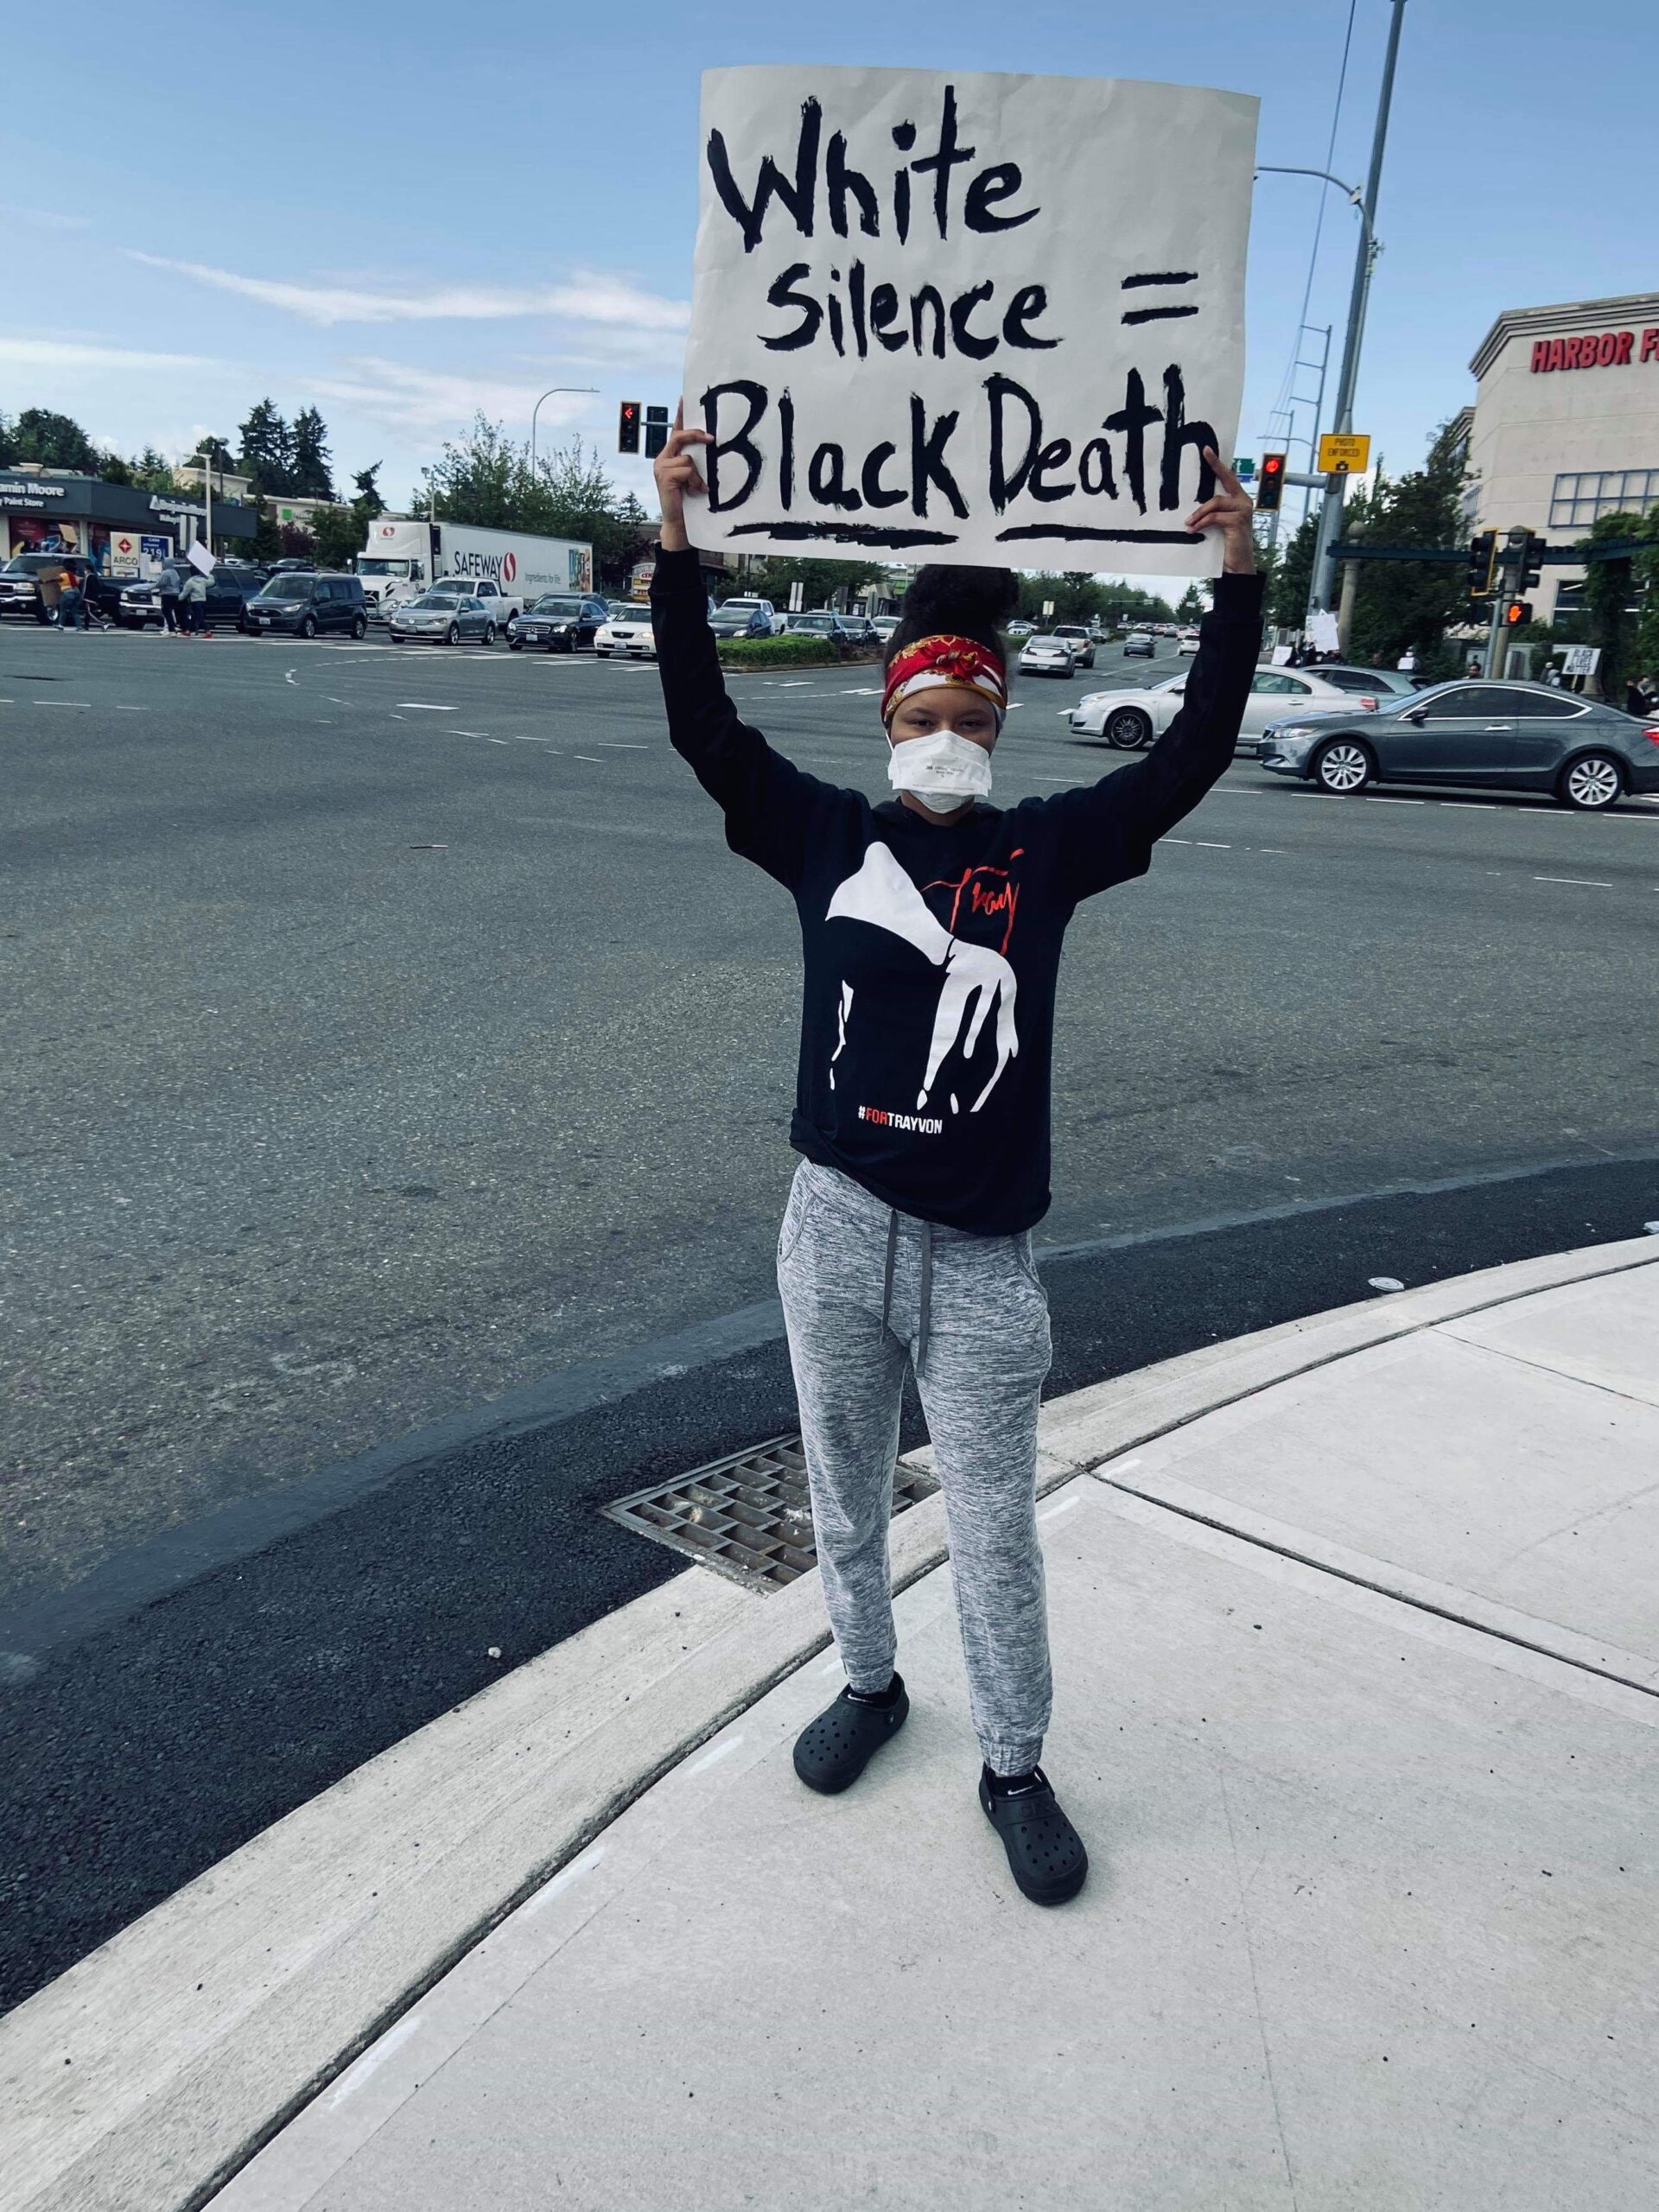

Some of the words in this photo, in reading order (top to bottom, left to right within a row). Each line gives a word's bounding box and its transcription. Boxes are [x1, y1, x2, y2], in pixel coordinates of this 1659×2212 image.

[707, 85, 1040, 253] White
[1121, 271, 1199, 326] =
[1530, 331, 1634, 373] HARBOR
[1640, 327, 1659, 363] F
[701, 379, 970, 520] Black
[981, 364, 1220, 517] Death
[1327, 448, 1360, 457] ENFORCED
[1334, 437, 1356, 447] PHOTO
[27, 482, 65, 497] Moore
[113, 556, 138, 566] ARCO
[454, 550, 503, 580] SAFEWAY
[857, 1105, 943, 1135] #FORTRAYVON
